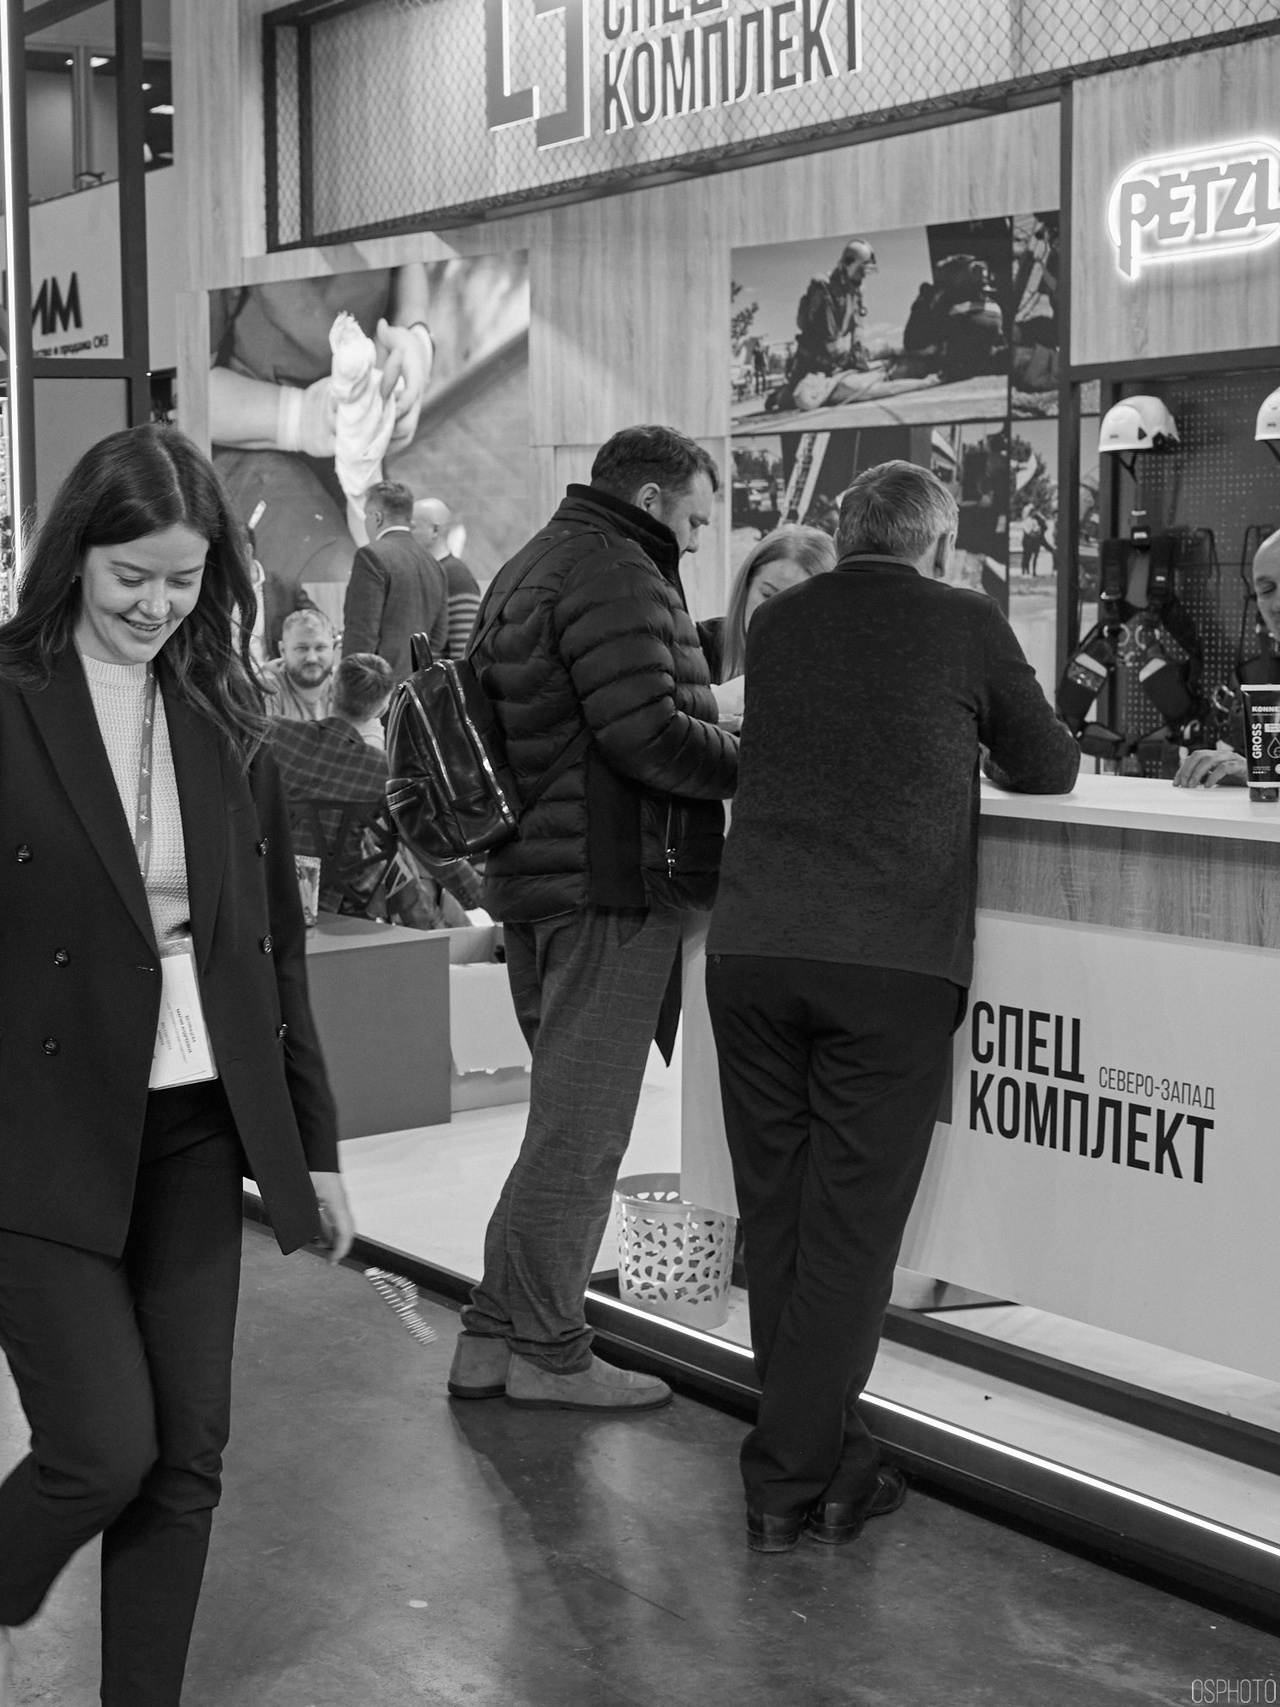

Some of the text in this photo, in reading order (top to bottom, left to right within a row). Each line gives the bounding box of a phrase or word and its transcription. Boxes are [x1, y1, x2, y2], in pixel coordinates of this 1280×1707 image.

[604, 0, 862, 134] КОМПЛЕКТ
[1118, 157, 1280, 278] PETZL
[1252, 723, 1262, 759] GROSS
[971, 1000, 1085, 1083] СПЕЦ
[1099, 1066, 1215, 1110] СЕВЕРО-ЗАПАД
[969, 1070, 1214, 1184] КОМПЛЕКТ
